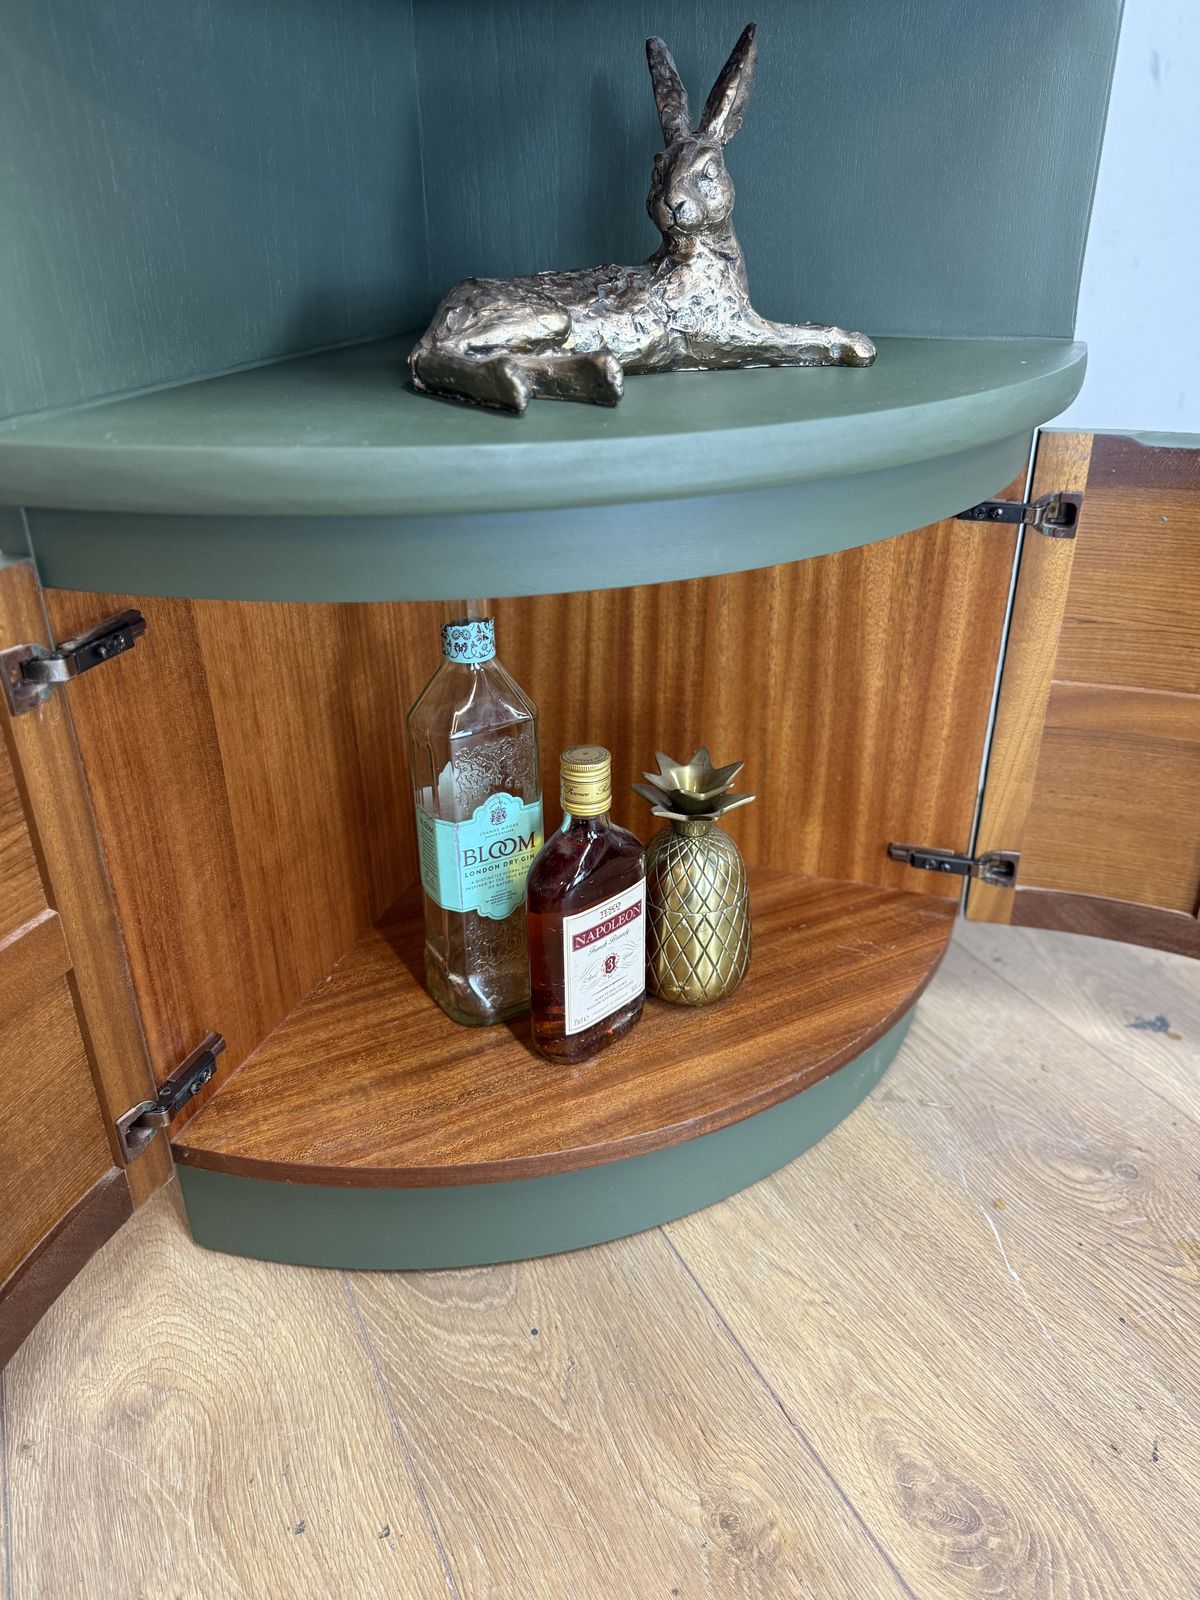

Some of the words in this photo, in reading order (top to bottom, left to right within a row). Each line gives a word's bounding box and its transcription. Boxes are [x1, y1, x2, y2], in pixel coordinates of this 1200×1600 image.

[462, 831, 536, 867] BLOOM
[464, 863, 500, 878] LONDON
[503, 858, 519, 868] DRY
[520, 853, 536, 863] GIN
[466, 881, 487, 891] INSPIRED
[599, 902, 622, 918] TESCO
[574, 903, 642, 949] NAPOLEON
[606, 957, 614, 972] 3
